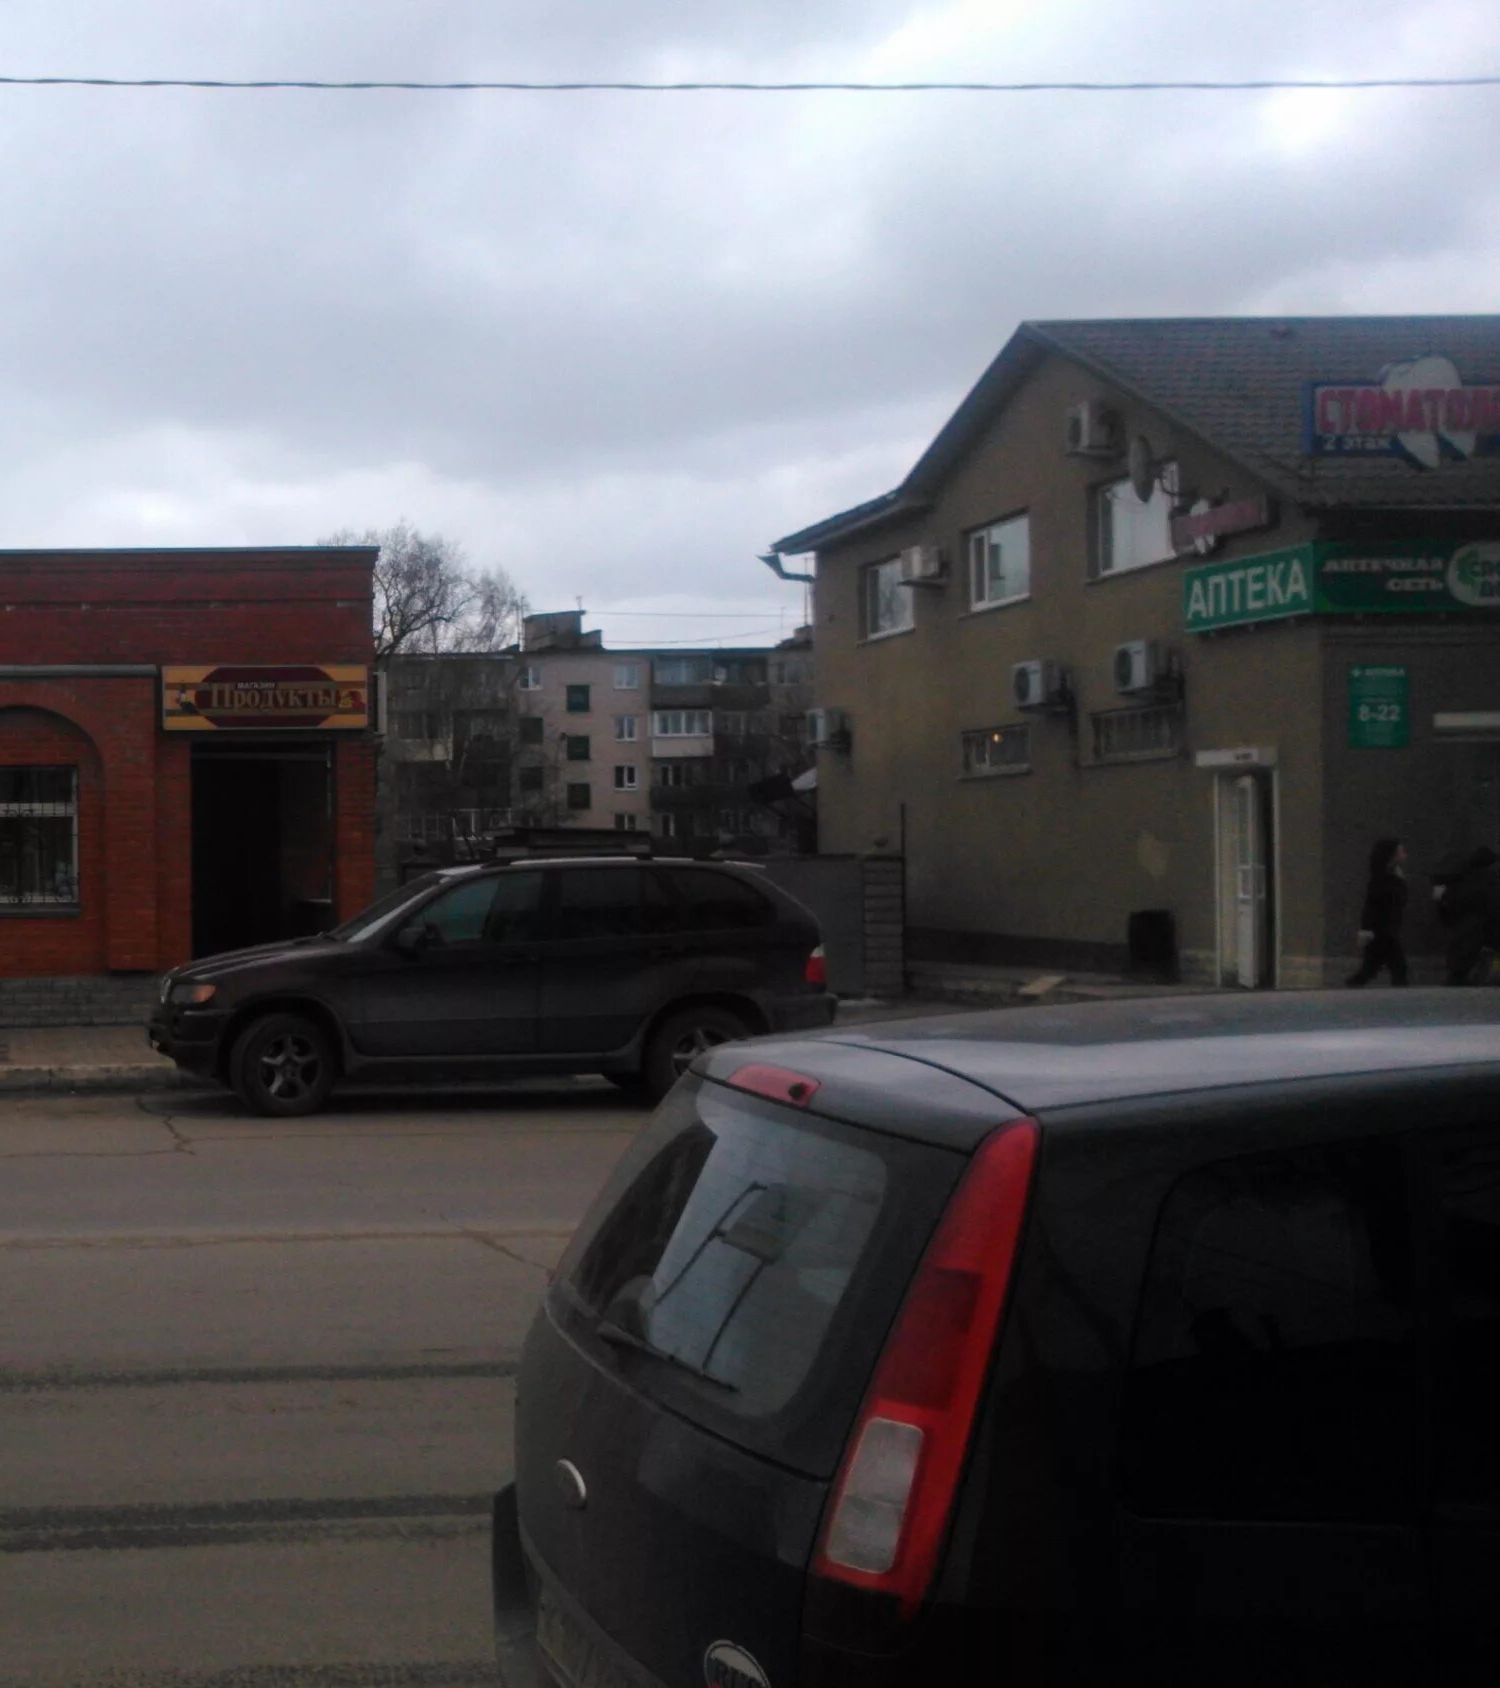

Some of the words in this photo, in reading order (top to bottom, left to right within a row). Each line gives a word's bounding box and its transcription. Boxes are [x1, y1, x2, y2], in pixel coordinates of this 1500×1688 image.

[1324, 434, 1336, 449] 2
[1187, 558, 1308, 620] АПТЕКА
[1357, 704, 1401, 721] 8-22
